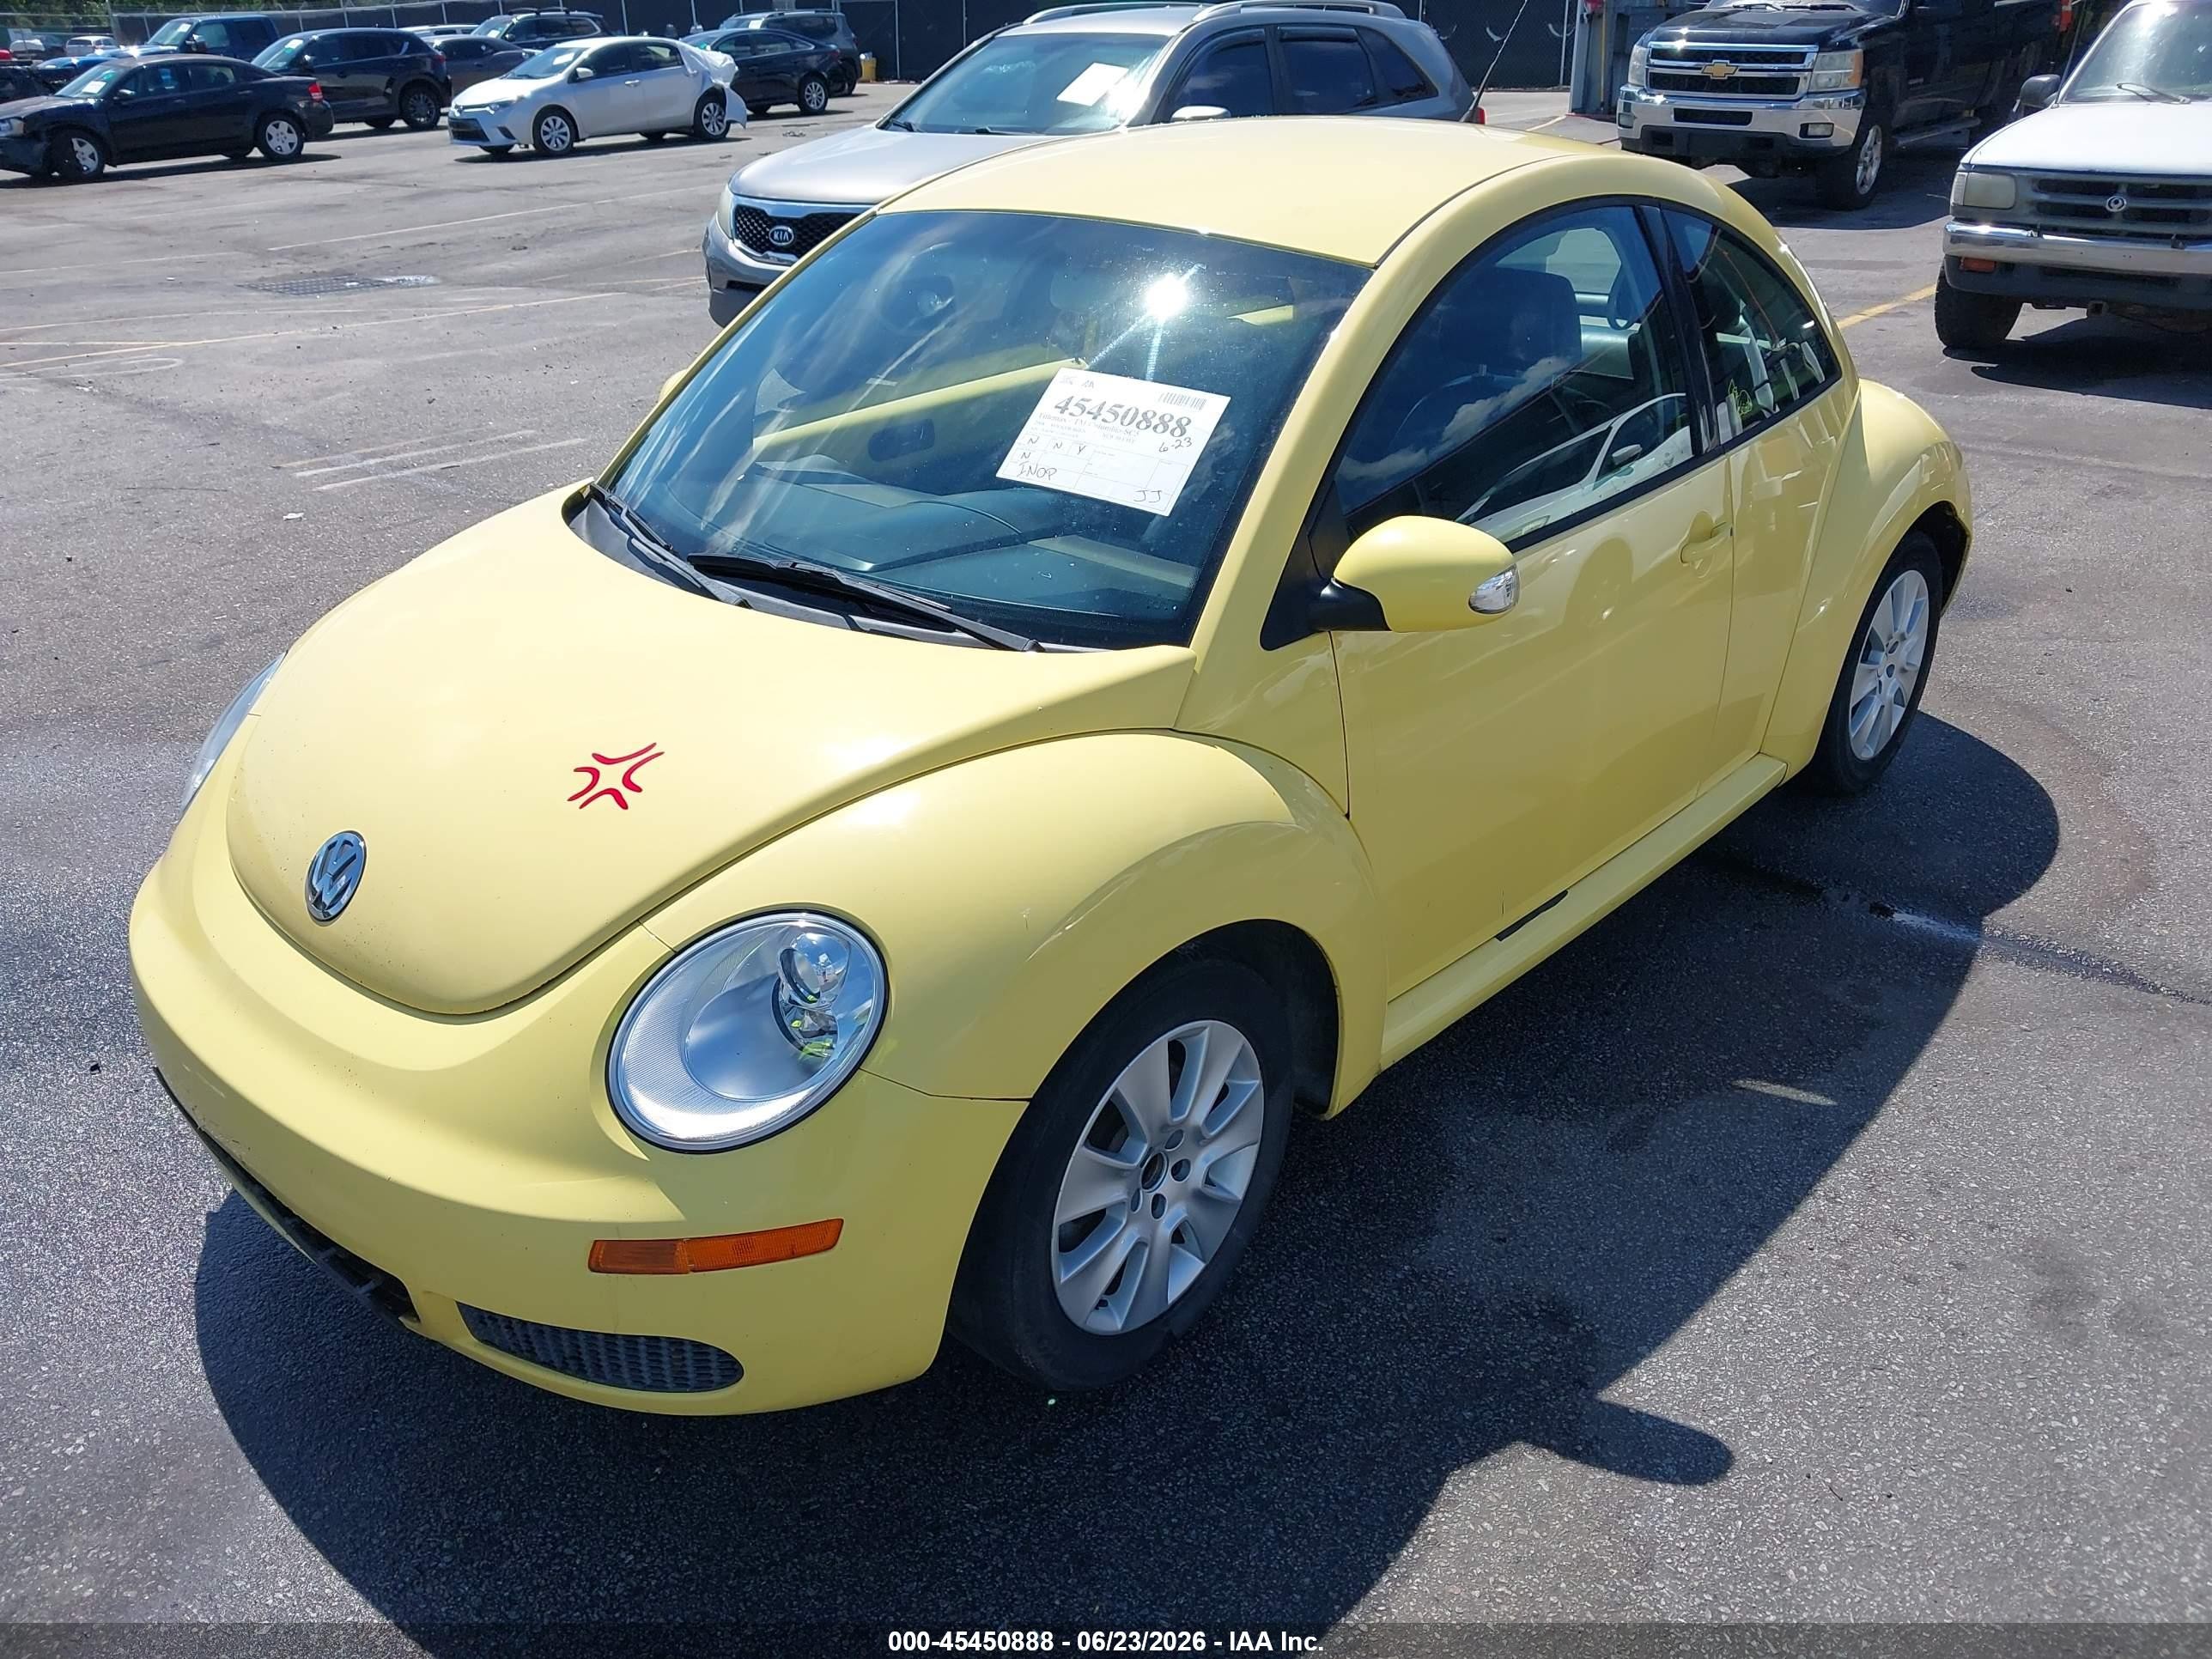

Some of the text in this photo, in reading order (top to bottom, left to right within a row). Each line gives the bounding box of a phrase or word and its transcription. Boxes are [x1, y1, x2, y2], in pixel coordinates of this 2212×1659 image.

[774, 230, 790, 241] KIA
[1054, 395, 1192, 438] 45450888
[1028, 435, 1040, 445] N
[1158, 436, 1193, 453] 6-23
[1020, 451, 1031, 459] N
[1017, 460, 1057, 481] INOP
